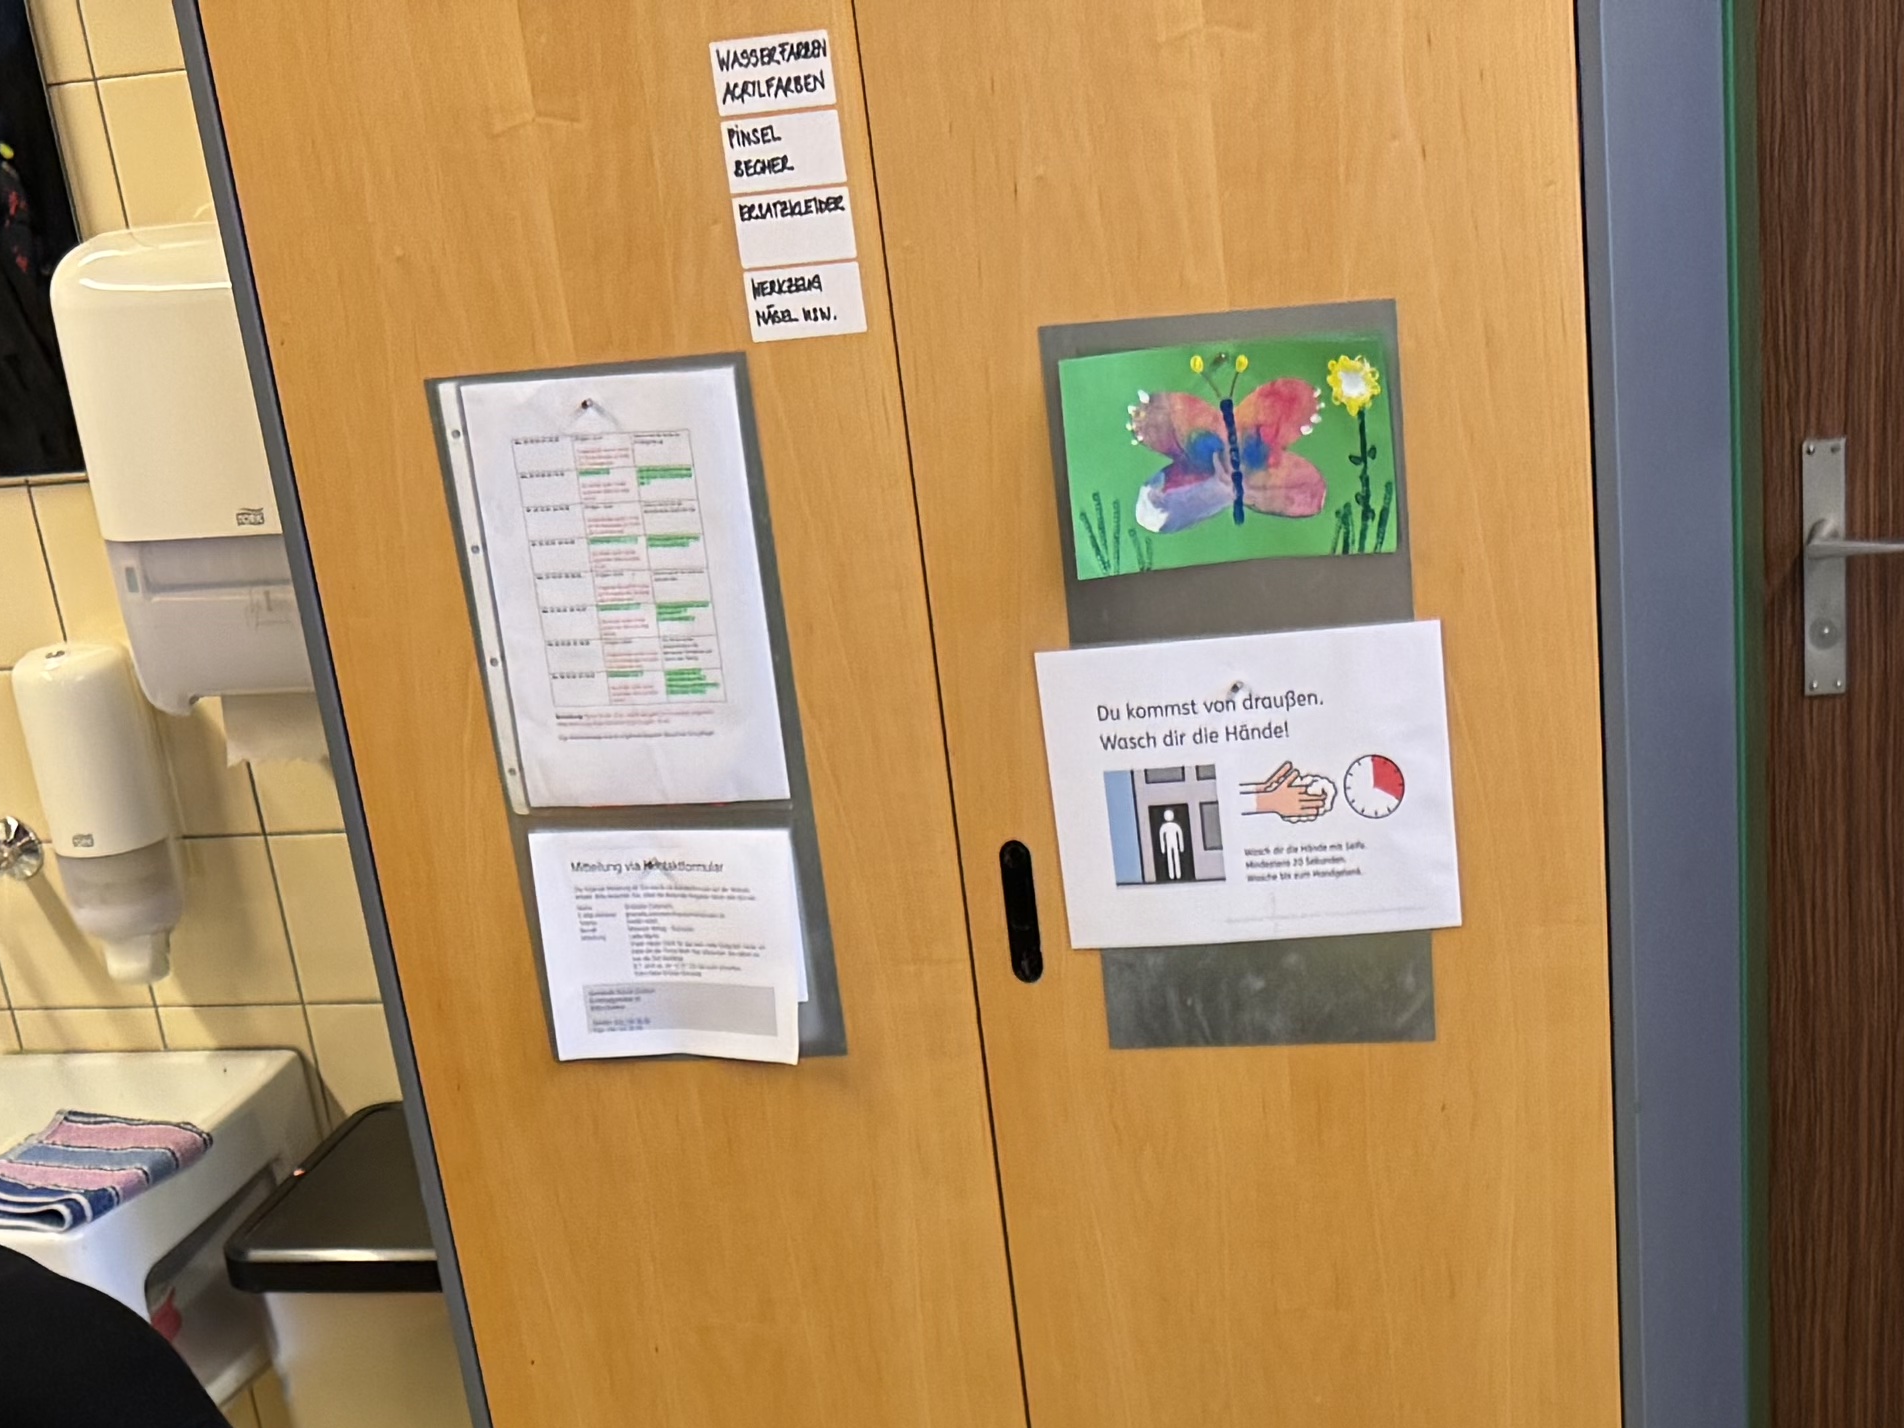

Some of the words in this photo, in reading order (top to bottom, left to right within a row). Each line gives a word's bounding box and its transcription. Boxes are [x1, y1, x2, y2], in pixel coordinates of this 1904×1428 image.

[715, 38, 827, 72] WASSERFARBEN
[734, 154, 795, 177] BECHER
[751, 273, 822, 300] WERKZEUG
[1097, 705, 1120, 722] Du
[1126, 700, 1198, 720] kommst
[1203, 699, 1236, 713] von
[1243, 690, 1324, 711] draußen.
[1100, 731, 1156, 751] Wasch
[1162, 730, 1187, 748] dir
[1192, 727, 1219, 745] die
[1226, 720, 1289, 742] Hände!
